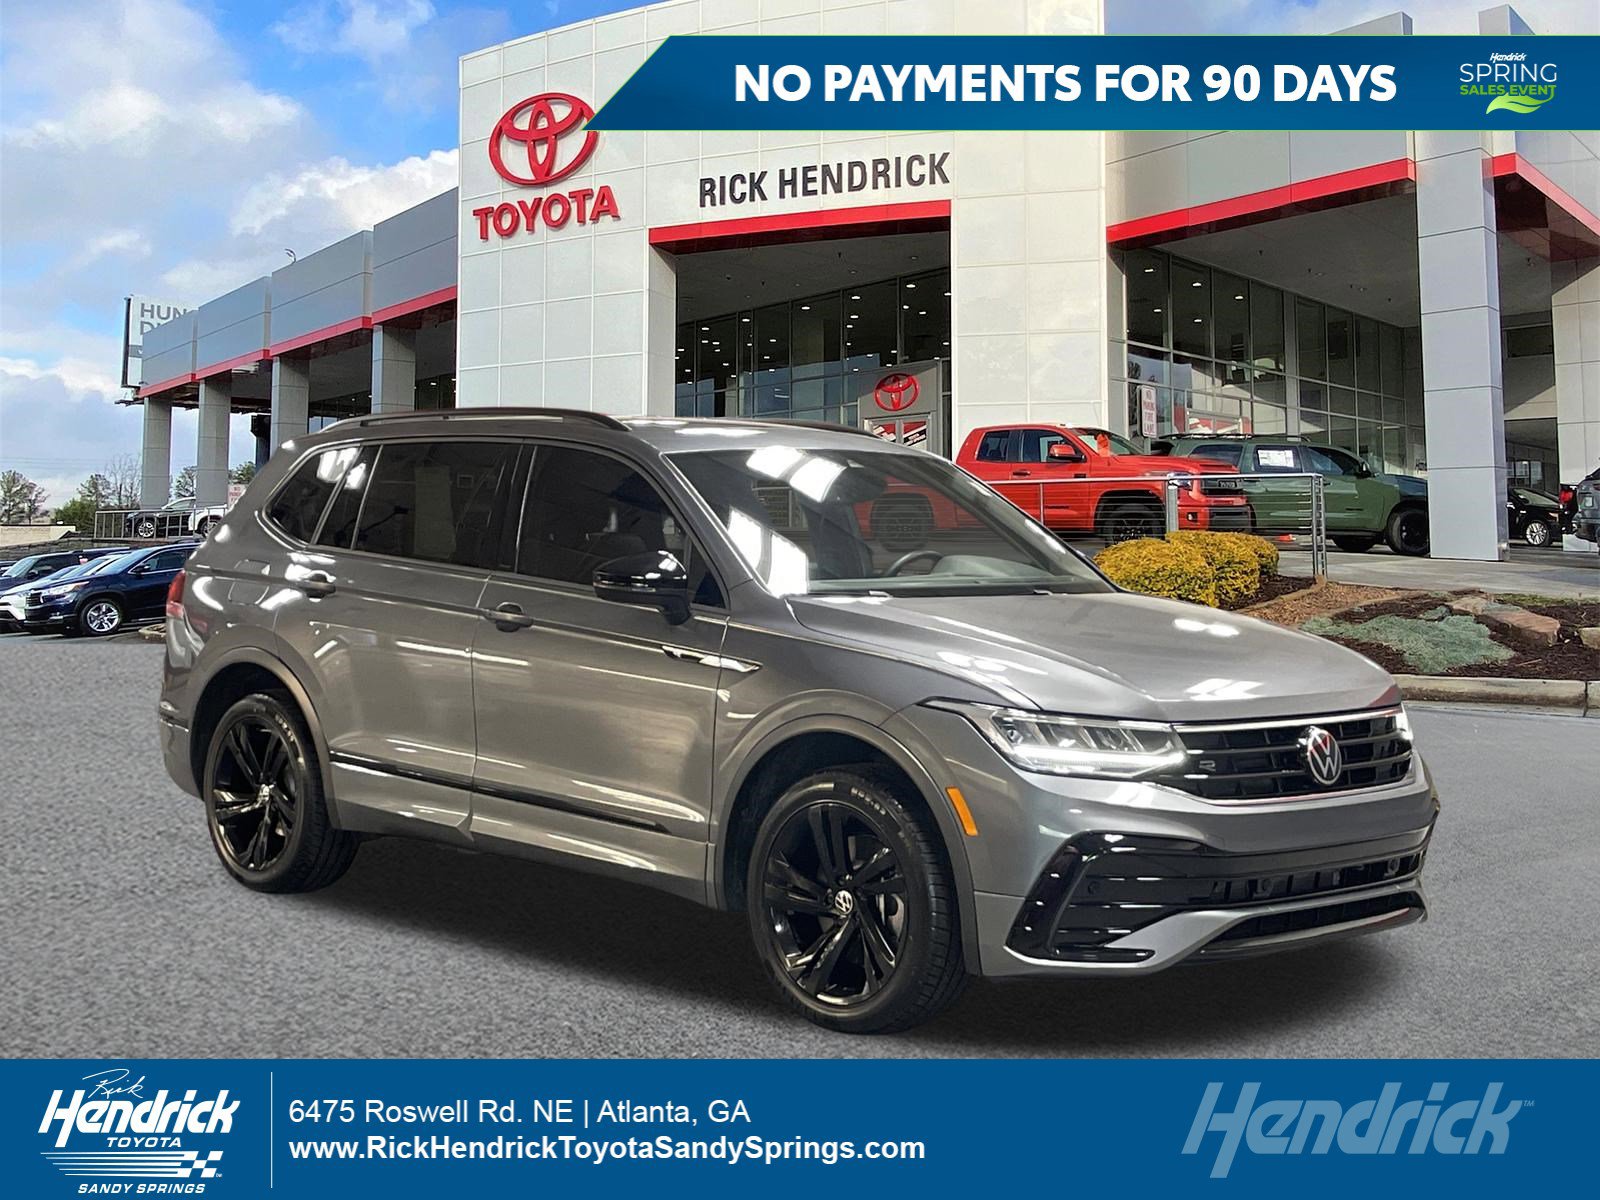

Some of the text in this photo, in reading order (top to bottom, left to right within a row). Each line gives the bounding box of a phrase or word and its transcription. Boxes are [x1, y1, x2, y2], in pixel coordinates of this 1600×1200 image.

[699, 152, 951, 208] RICK HENDRICK
[473, 185, 620, 240] TOYOTA
